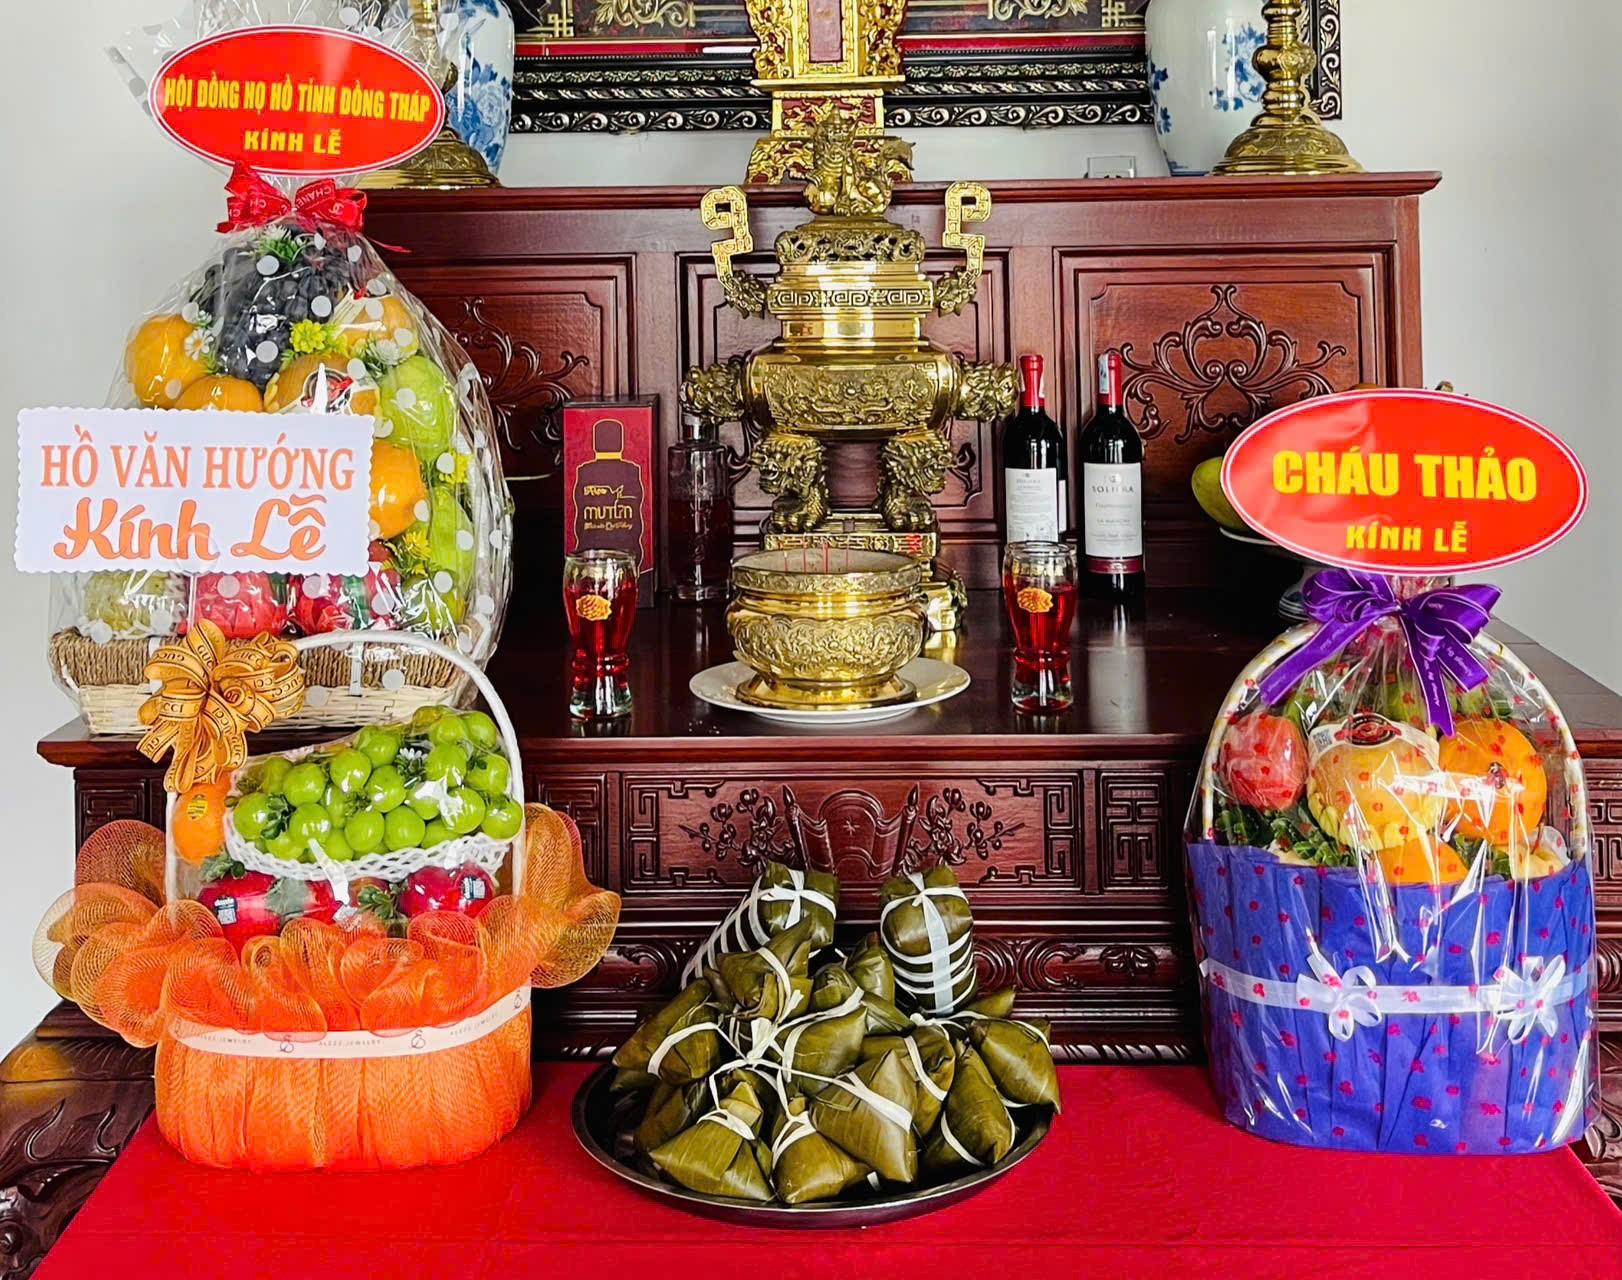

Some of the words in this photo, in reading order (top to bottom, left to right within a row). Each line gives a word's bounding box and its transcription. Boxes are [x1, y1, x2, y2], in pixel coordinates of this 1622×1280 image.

[165, 74, 193, 112] HỘI
[197, 71, 240, 109] ĐỒNG
[244, 81, 266, 115] HỌ
[270, 73, 293, 111] HỒ
[298, 78, 336, 114] TỈNH
[339, 80, 385, 119] ĐỒNG
[389, 90, 431, 122] THÁP
[244, 130, 303, 152] KÍNH
[313, 129, 342, 155] LỄ
[40, 424, 98, 487] HỒ
[110, 431, 191, 488] VĂN
[202, 433, 356, 490] HƯỚNG
[1272, 446, 1398, 496] CHÁU
[1414, 447, 1537, 501] THẢO
[53, 497, 220, 560] Kính
[230, 494, 328, 561] Lễ
[1346, 521, 1421, 551] KÍNH
[1434, 521, 1467, 552] LỄ
